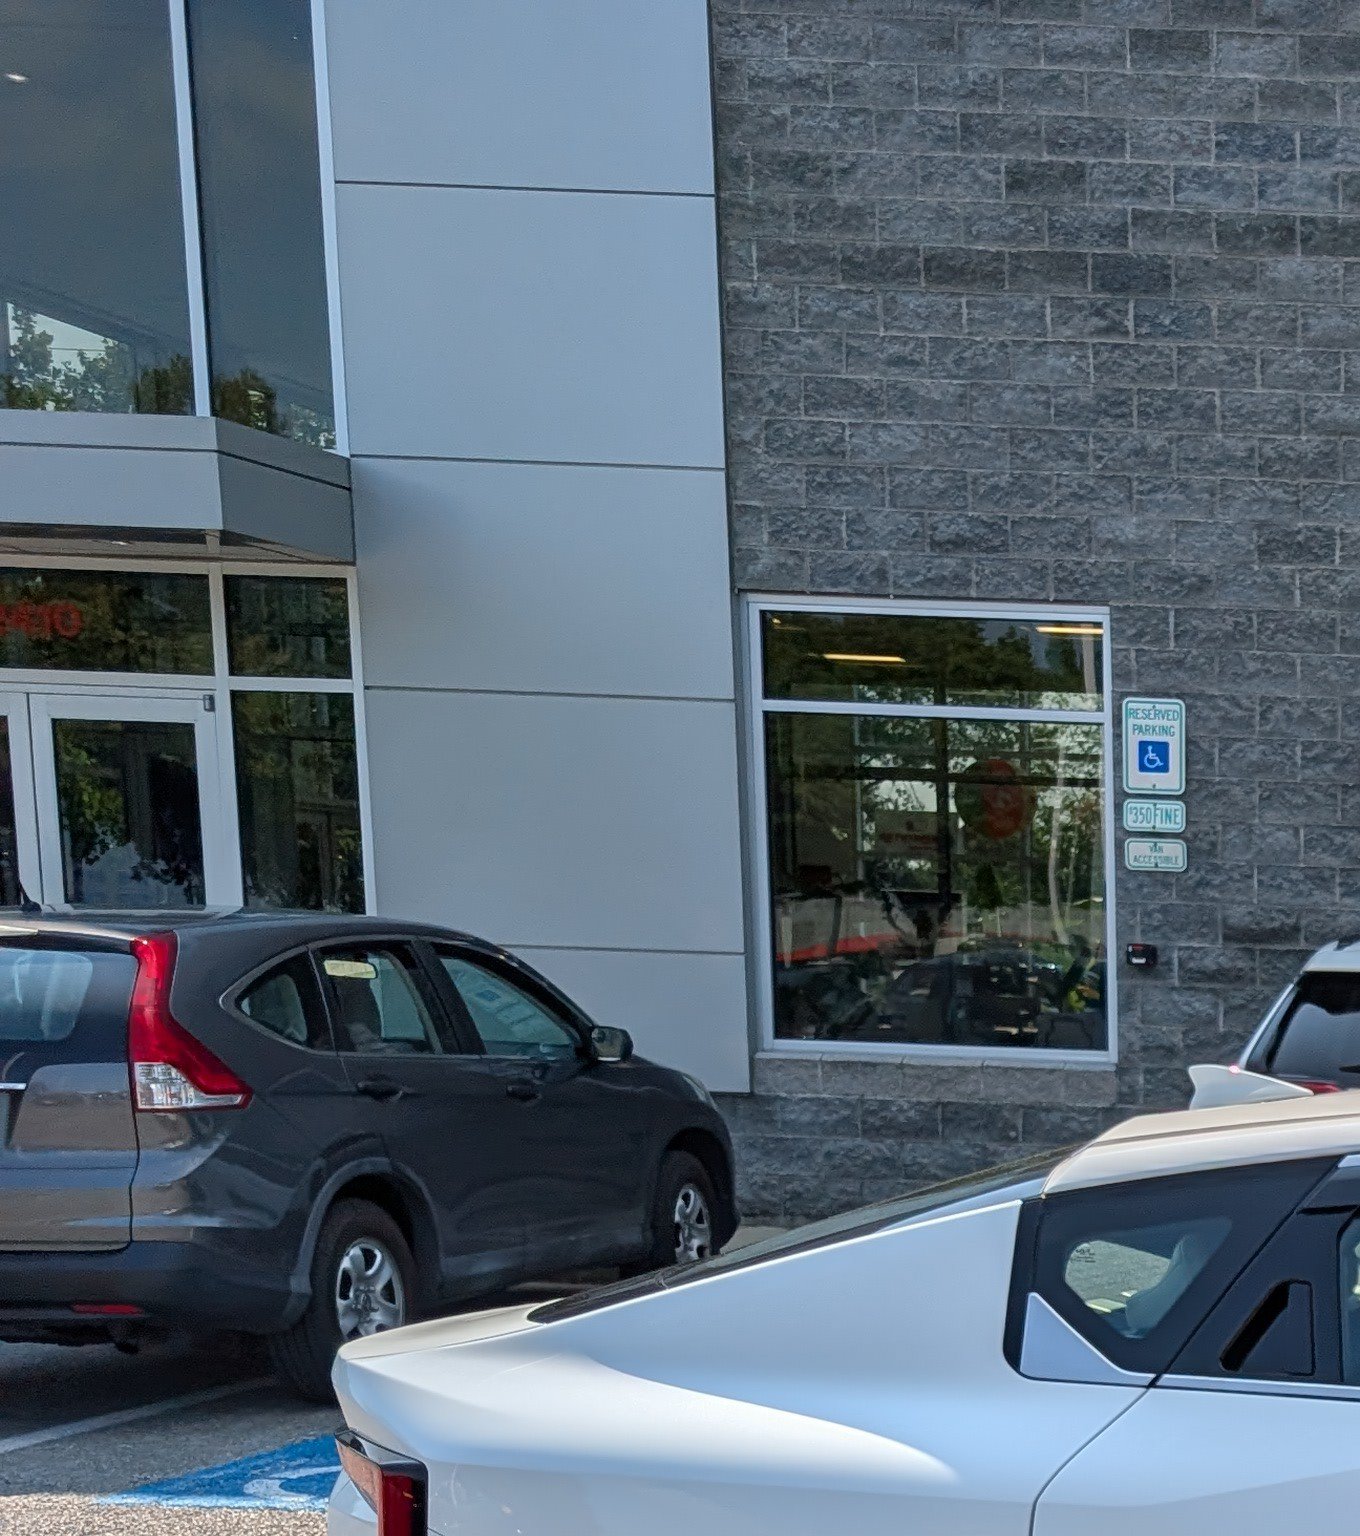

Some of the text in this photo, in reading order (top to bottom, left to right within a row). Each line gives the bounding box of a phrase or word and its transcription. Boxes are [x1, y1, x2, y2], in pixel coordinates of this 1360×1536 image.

[1128, 707, 1180, 722] RESERVED
[1132, 724, 1176, 737] PARKING
[1129, 806, 1180, 825] $350 FINE
